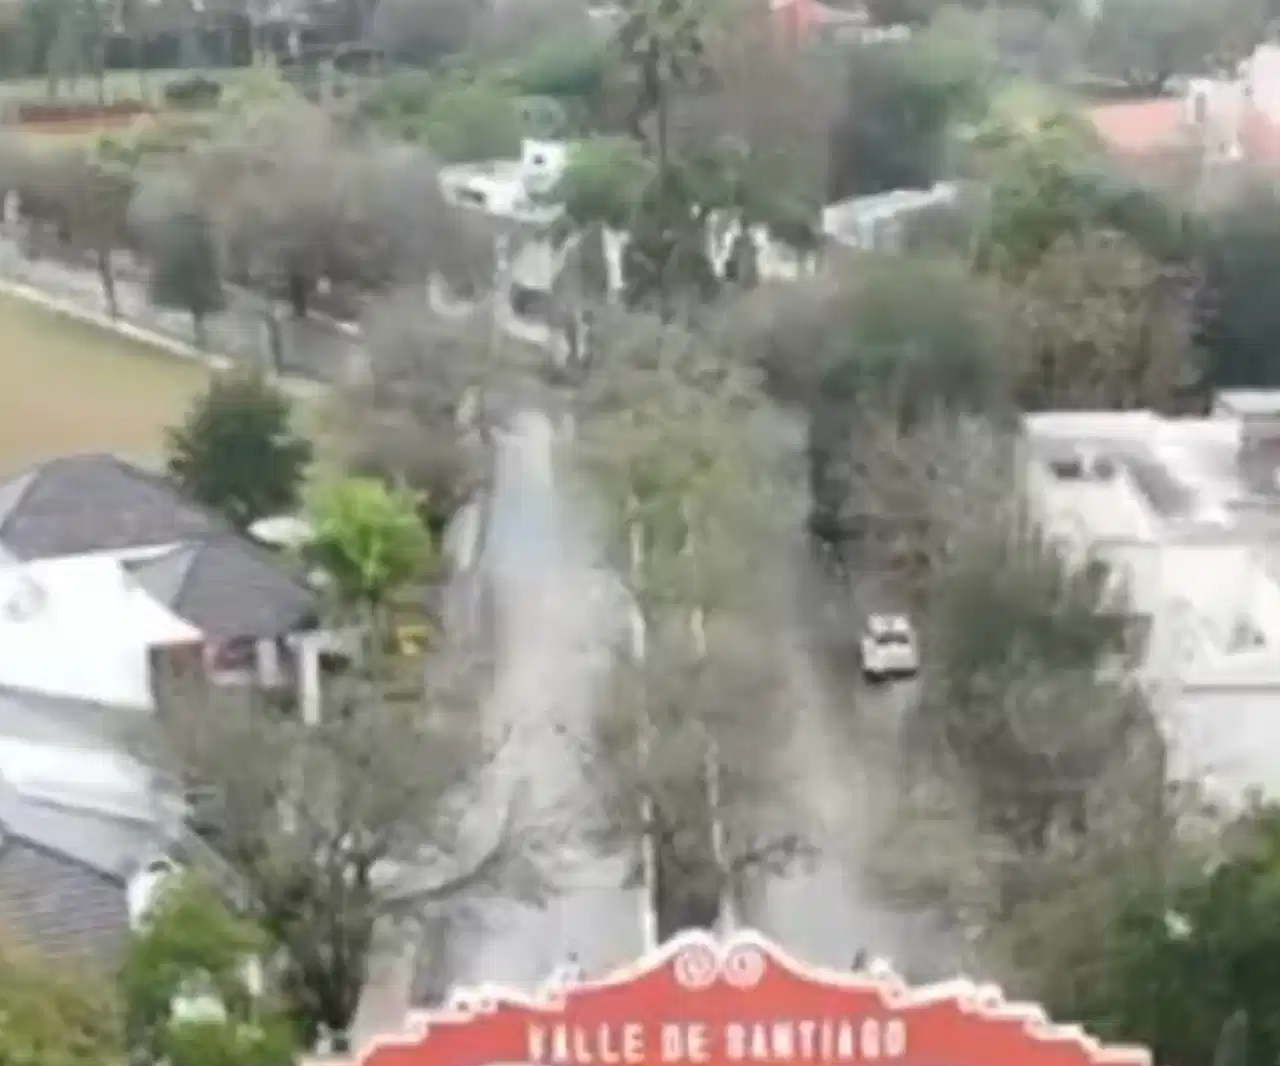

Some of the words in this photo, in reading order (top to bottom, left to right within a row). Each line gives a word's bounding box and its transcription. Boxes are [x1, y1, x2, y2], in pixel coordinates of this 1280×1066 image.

[528, 1021, 645, 1064] VALLE
[661, 1021, 710, 1063] DE
[724, 1017, 907, 1062] SANTIAGO
